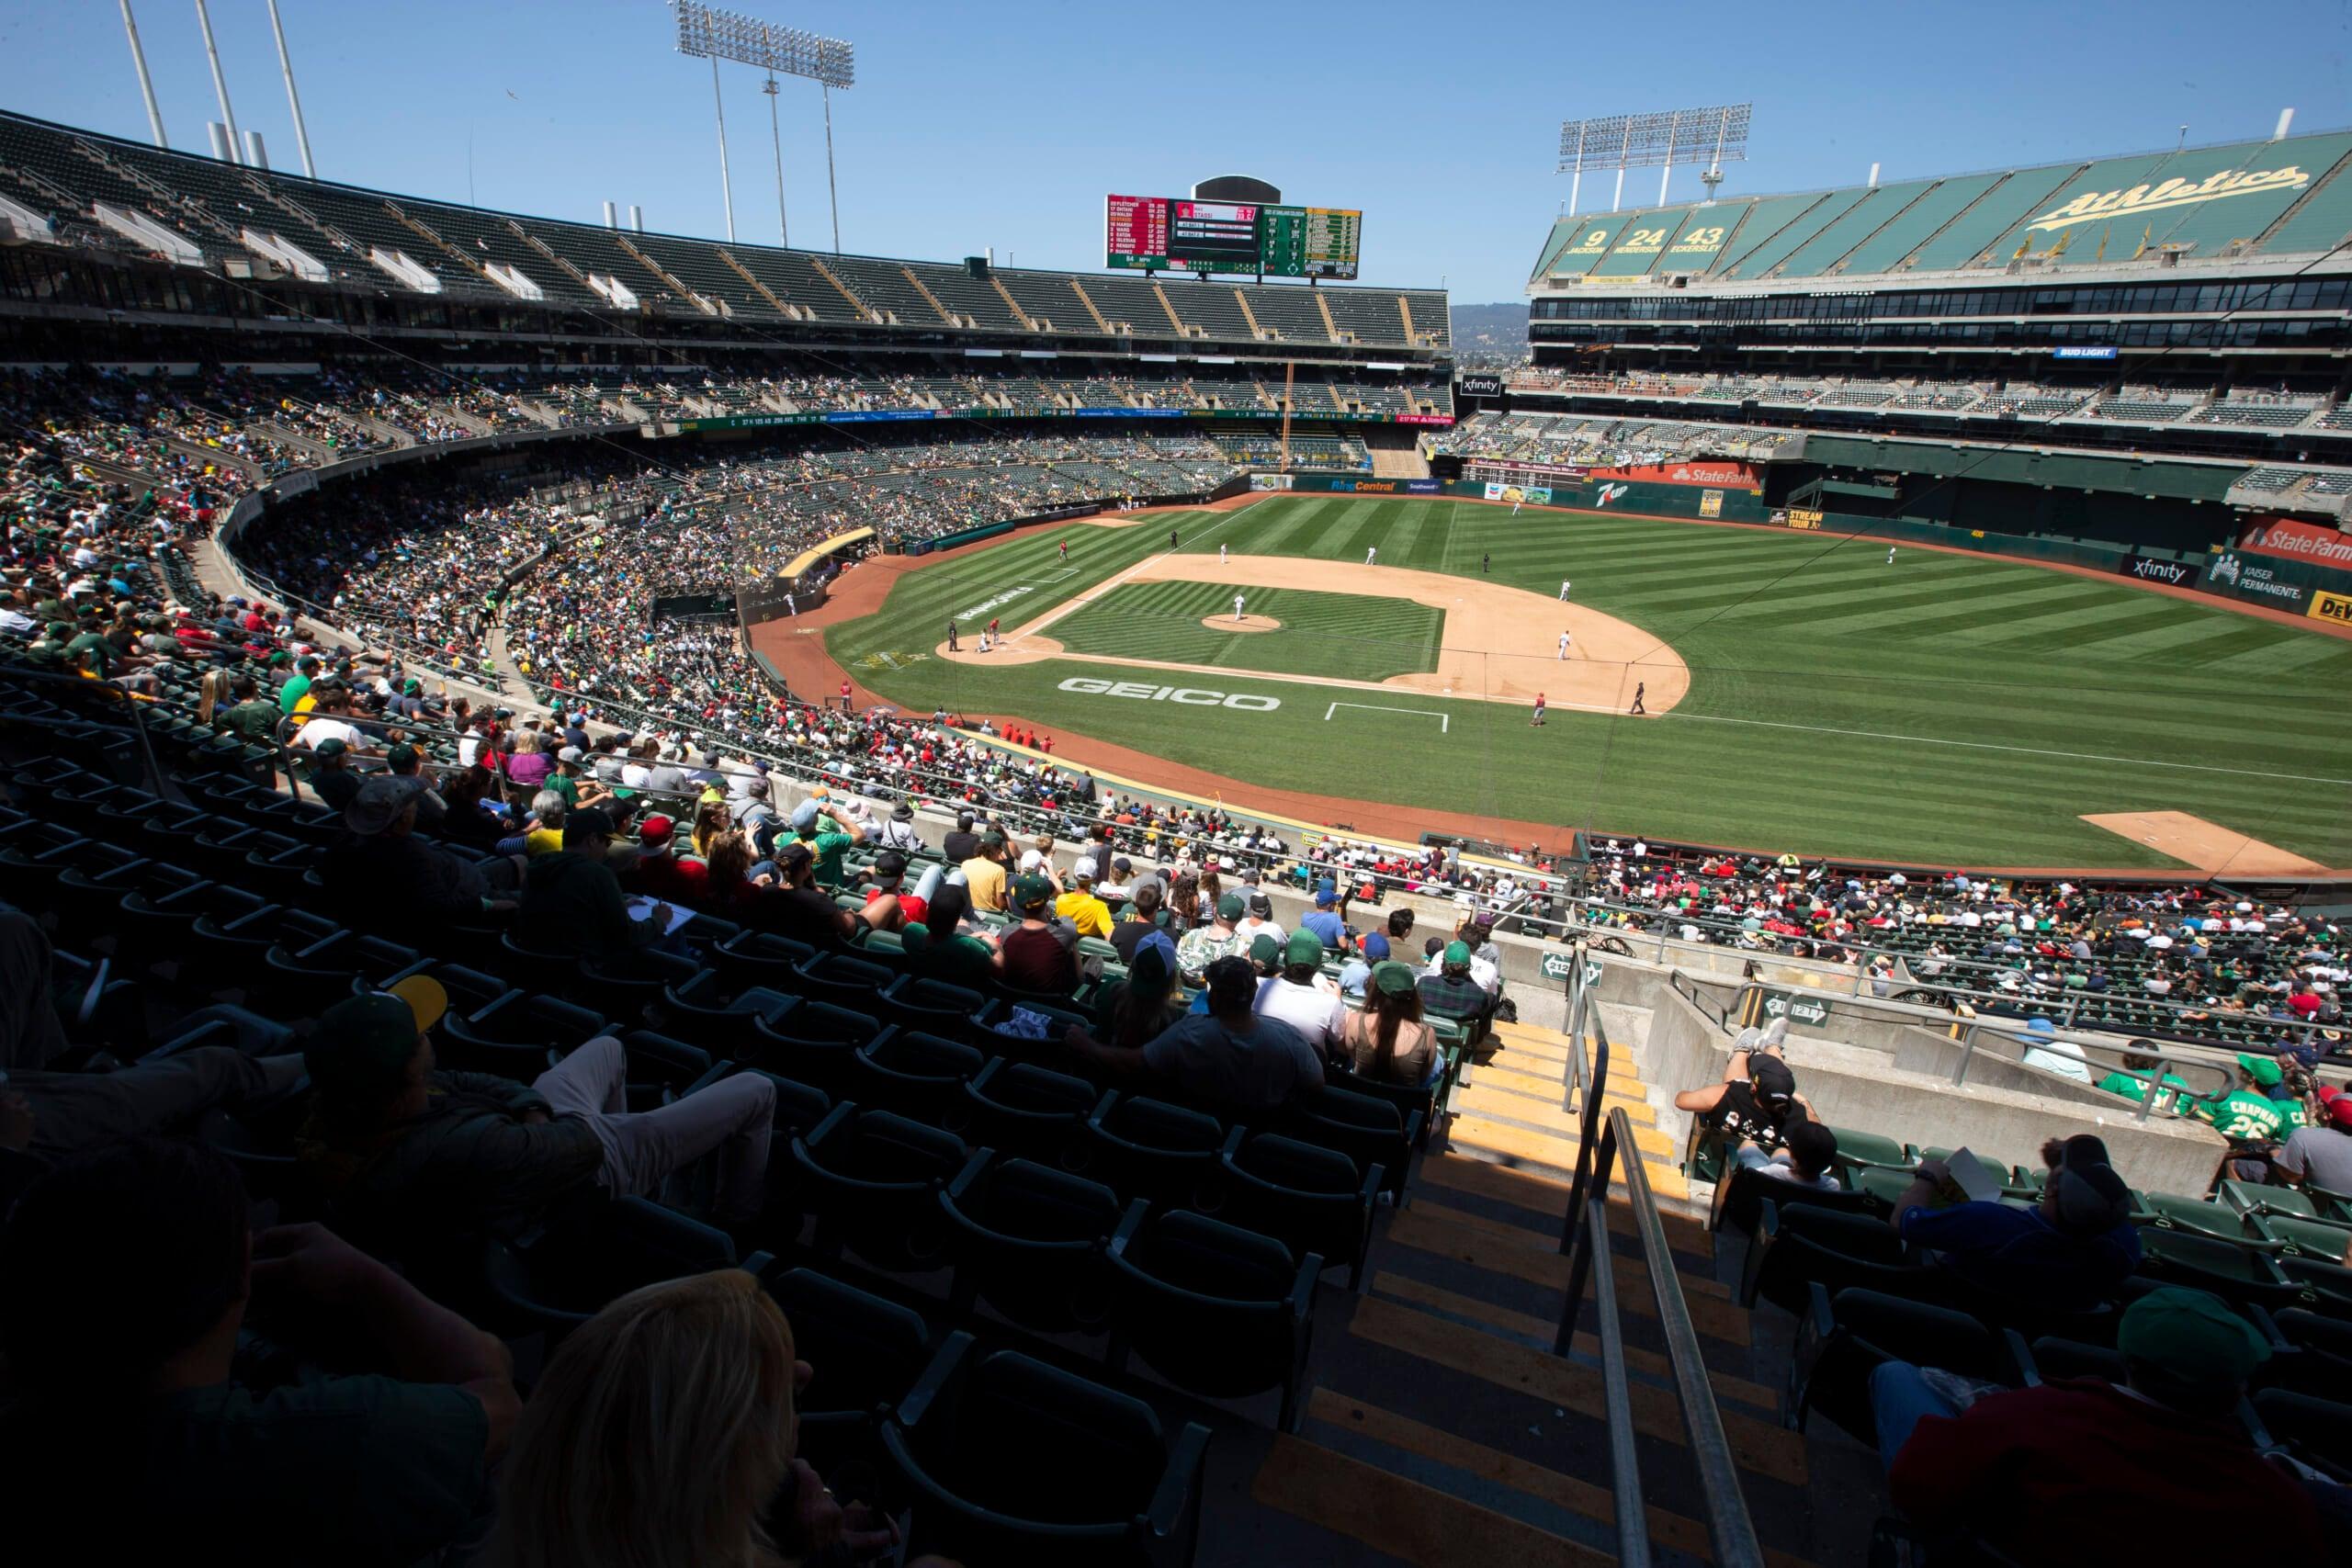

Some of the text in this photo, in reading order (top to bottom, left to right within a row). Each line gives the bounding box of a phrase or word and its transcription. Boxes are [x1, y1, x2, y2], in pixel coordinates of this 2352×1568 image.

[2025, 165, 2309, 231] Athletics
[1584, 230, 1607, 247] 9
[1625, 229, 1667, 246] 24
[1684, 227, 1724, 245] 43
[1669, 243, 1723, 254] ECKERSLEY
[2060, 348, 2111, 356] BUD LIGHT
[1464, 378, 1498, 392] xfinity
[1331, 480, 1396, 491] RingCentral
[1790, 510, 1824, 522] STREAM
[1789, 519, 1809, 529] YOUR
[2133, 558, 2187, 583] xfinity
[2244, 566, 2274, 580] KAISER
[2239, 578, 2301, 600] PERMANENTE
[1057, 677, 1282, 711] GEICO
[1550, 962, 1569, 972] 212
